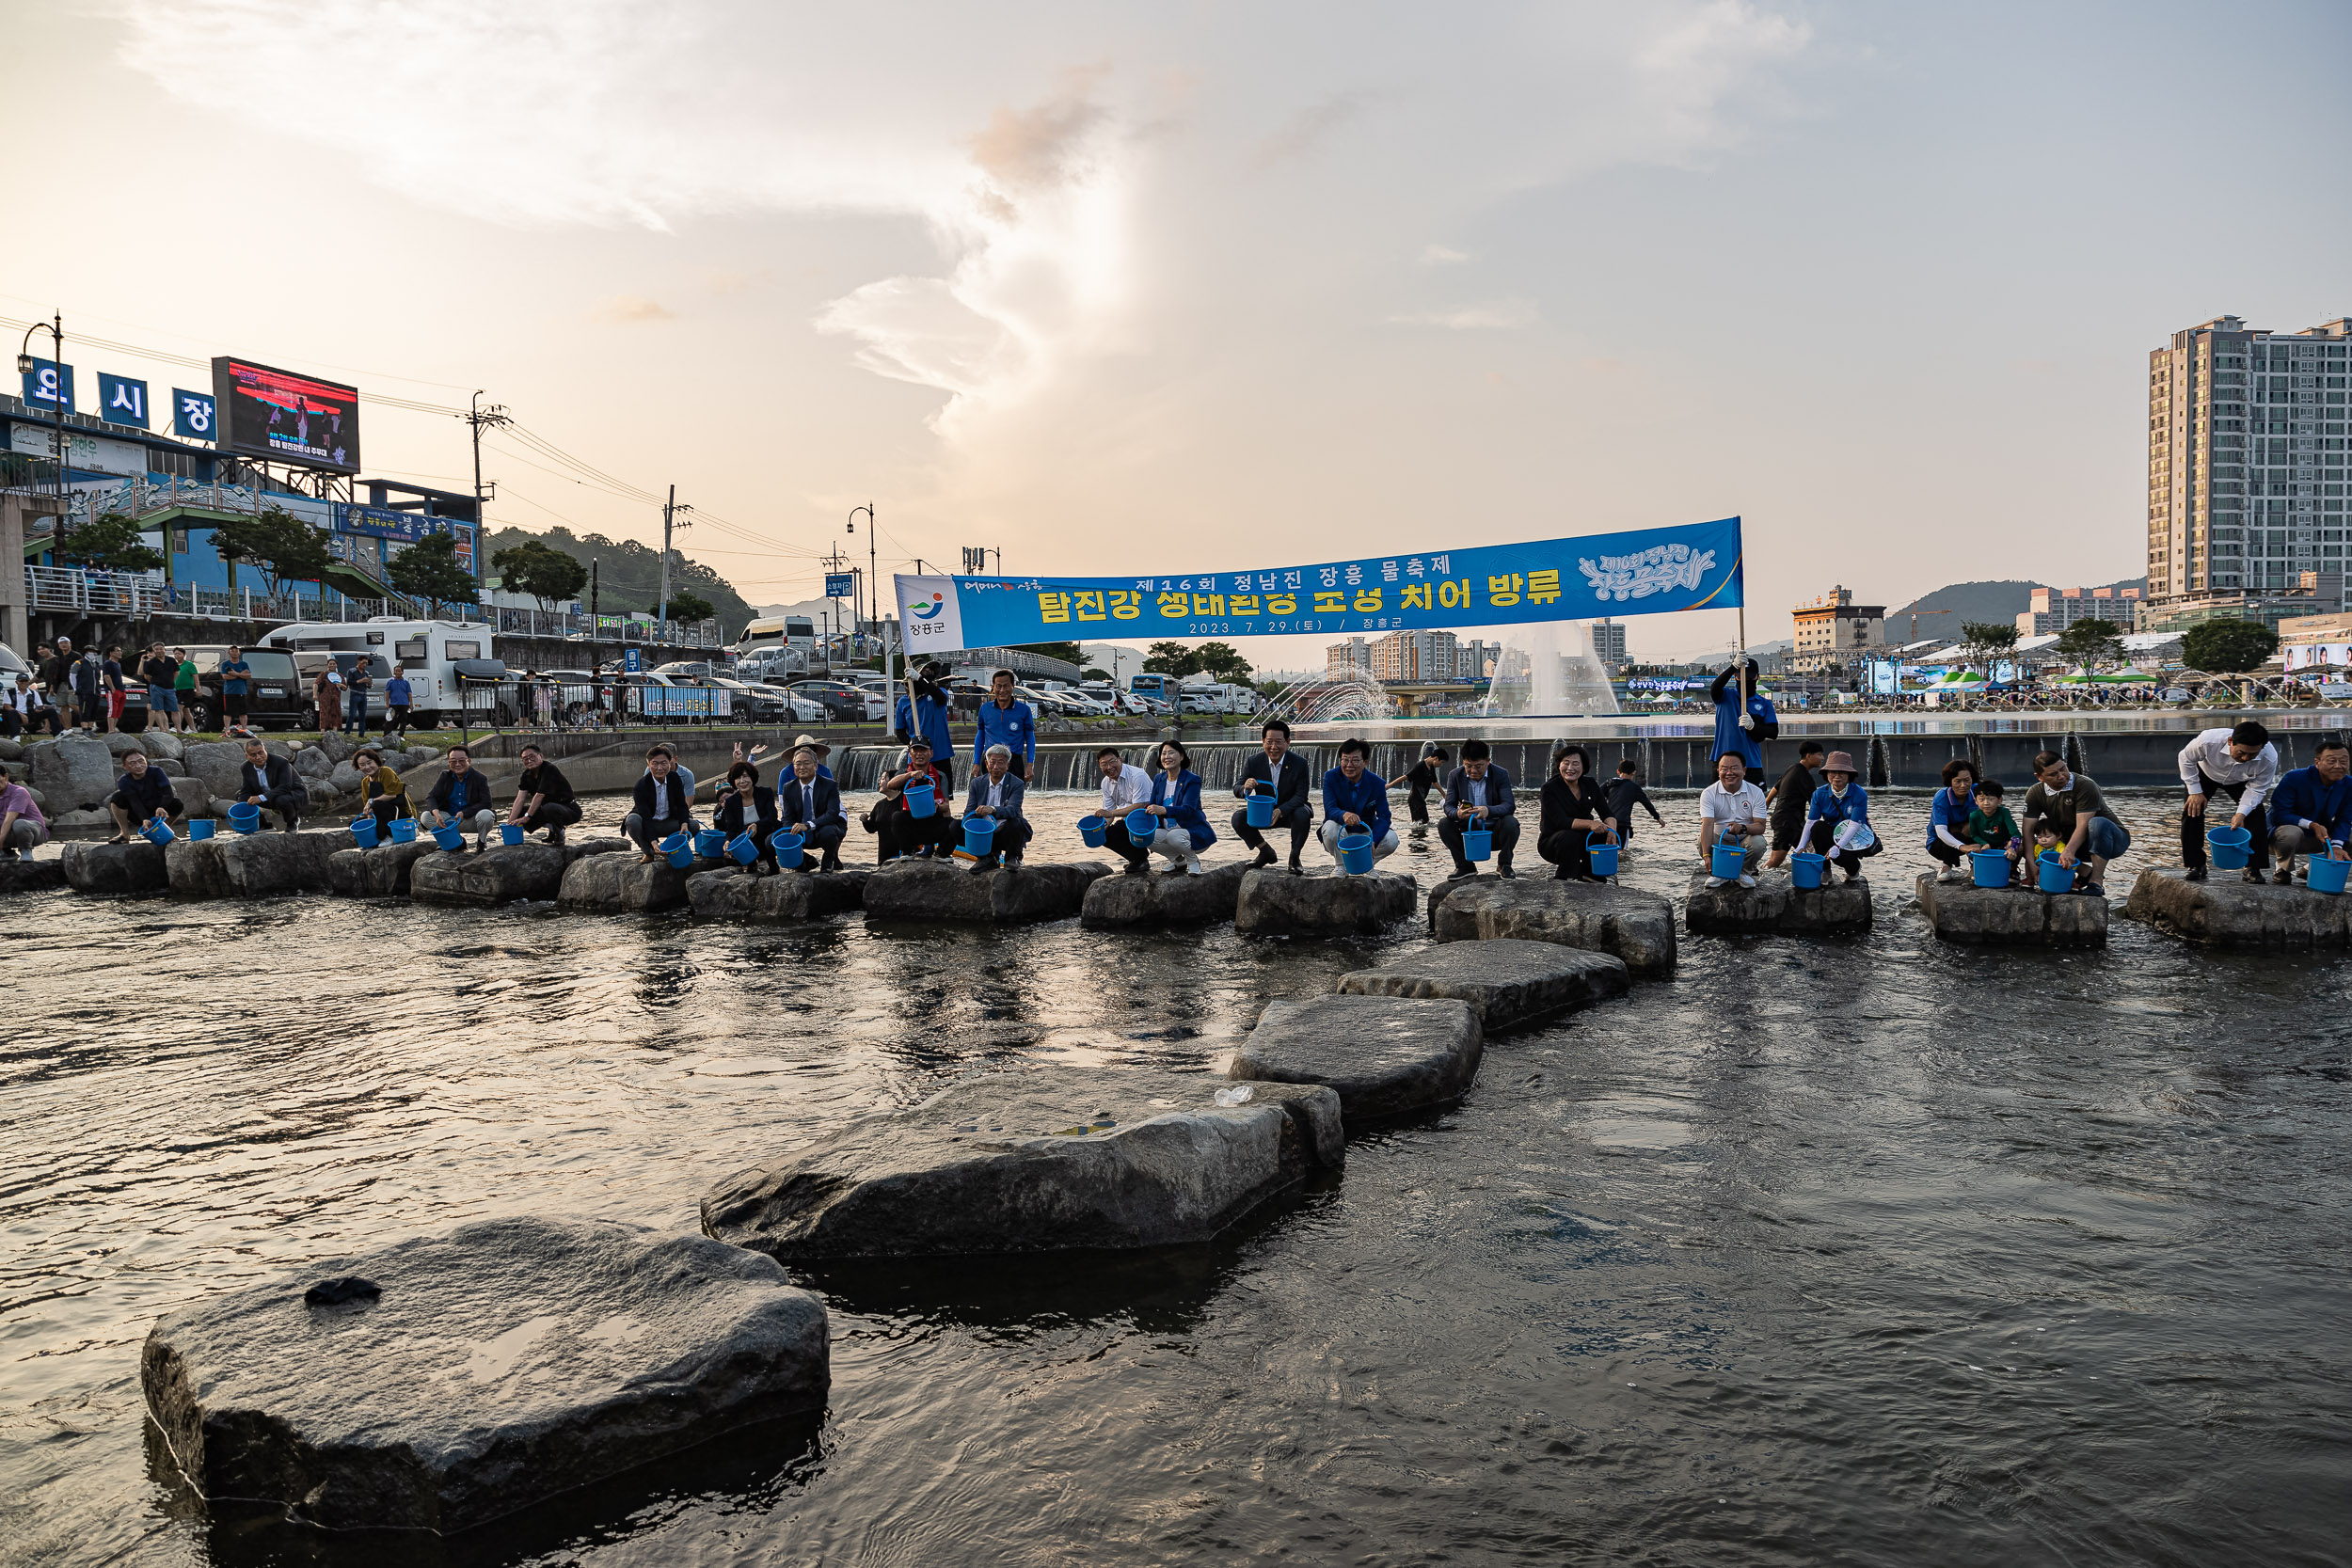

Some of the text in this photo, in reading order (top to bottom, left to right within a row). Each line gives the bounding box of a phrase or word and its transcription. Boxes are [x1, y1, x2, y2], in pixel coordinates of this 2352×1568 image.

[33, 368, 213, 432] 요 시 장
[311, 447, 327, 456] 주무대
[1600, 543, 1690, 572] 제16회 정남진
[1136, 554, 1451, 593] 제16회 정남진 장흥 물축제
[1038, 590, 1143, 624] 탐진강
[1313, 587, 1384, 613] 조성
[1400, 578, 1470, 610] 치어
[1487, 568, 1562, 608] 방류
[909, 622, 946, 636] 장흥군
[1189, 623, 1235, 634] 2023.
[1246, 622, 1258, 633] 7.
[1268, 619, 1322, 632] 29.(토)
[1363, 617, 1403, 629] 장흥군
